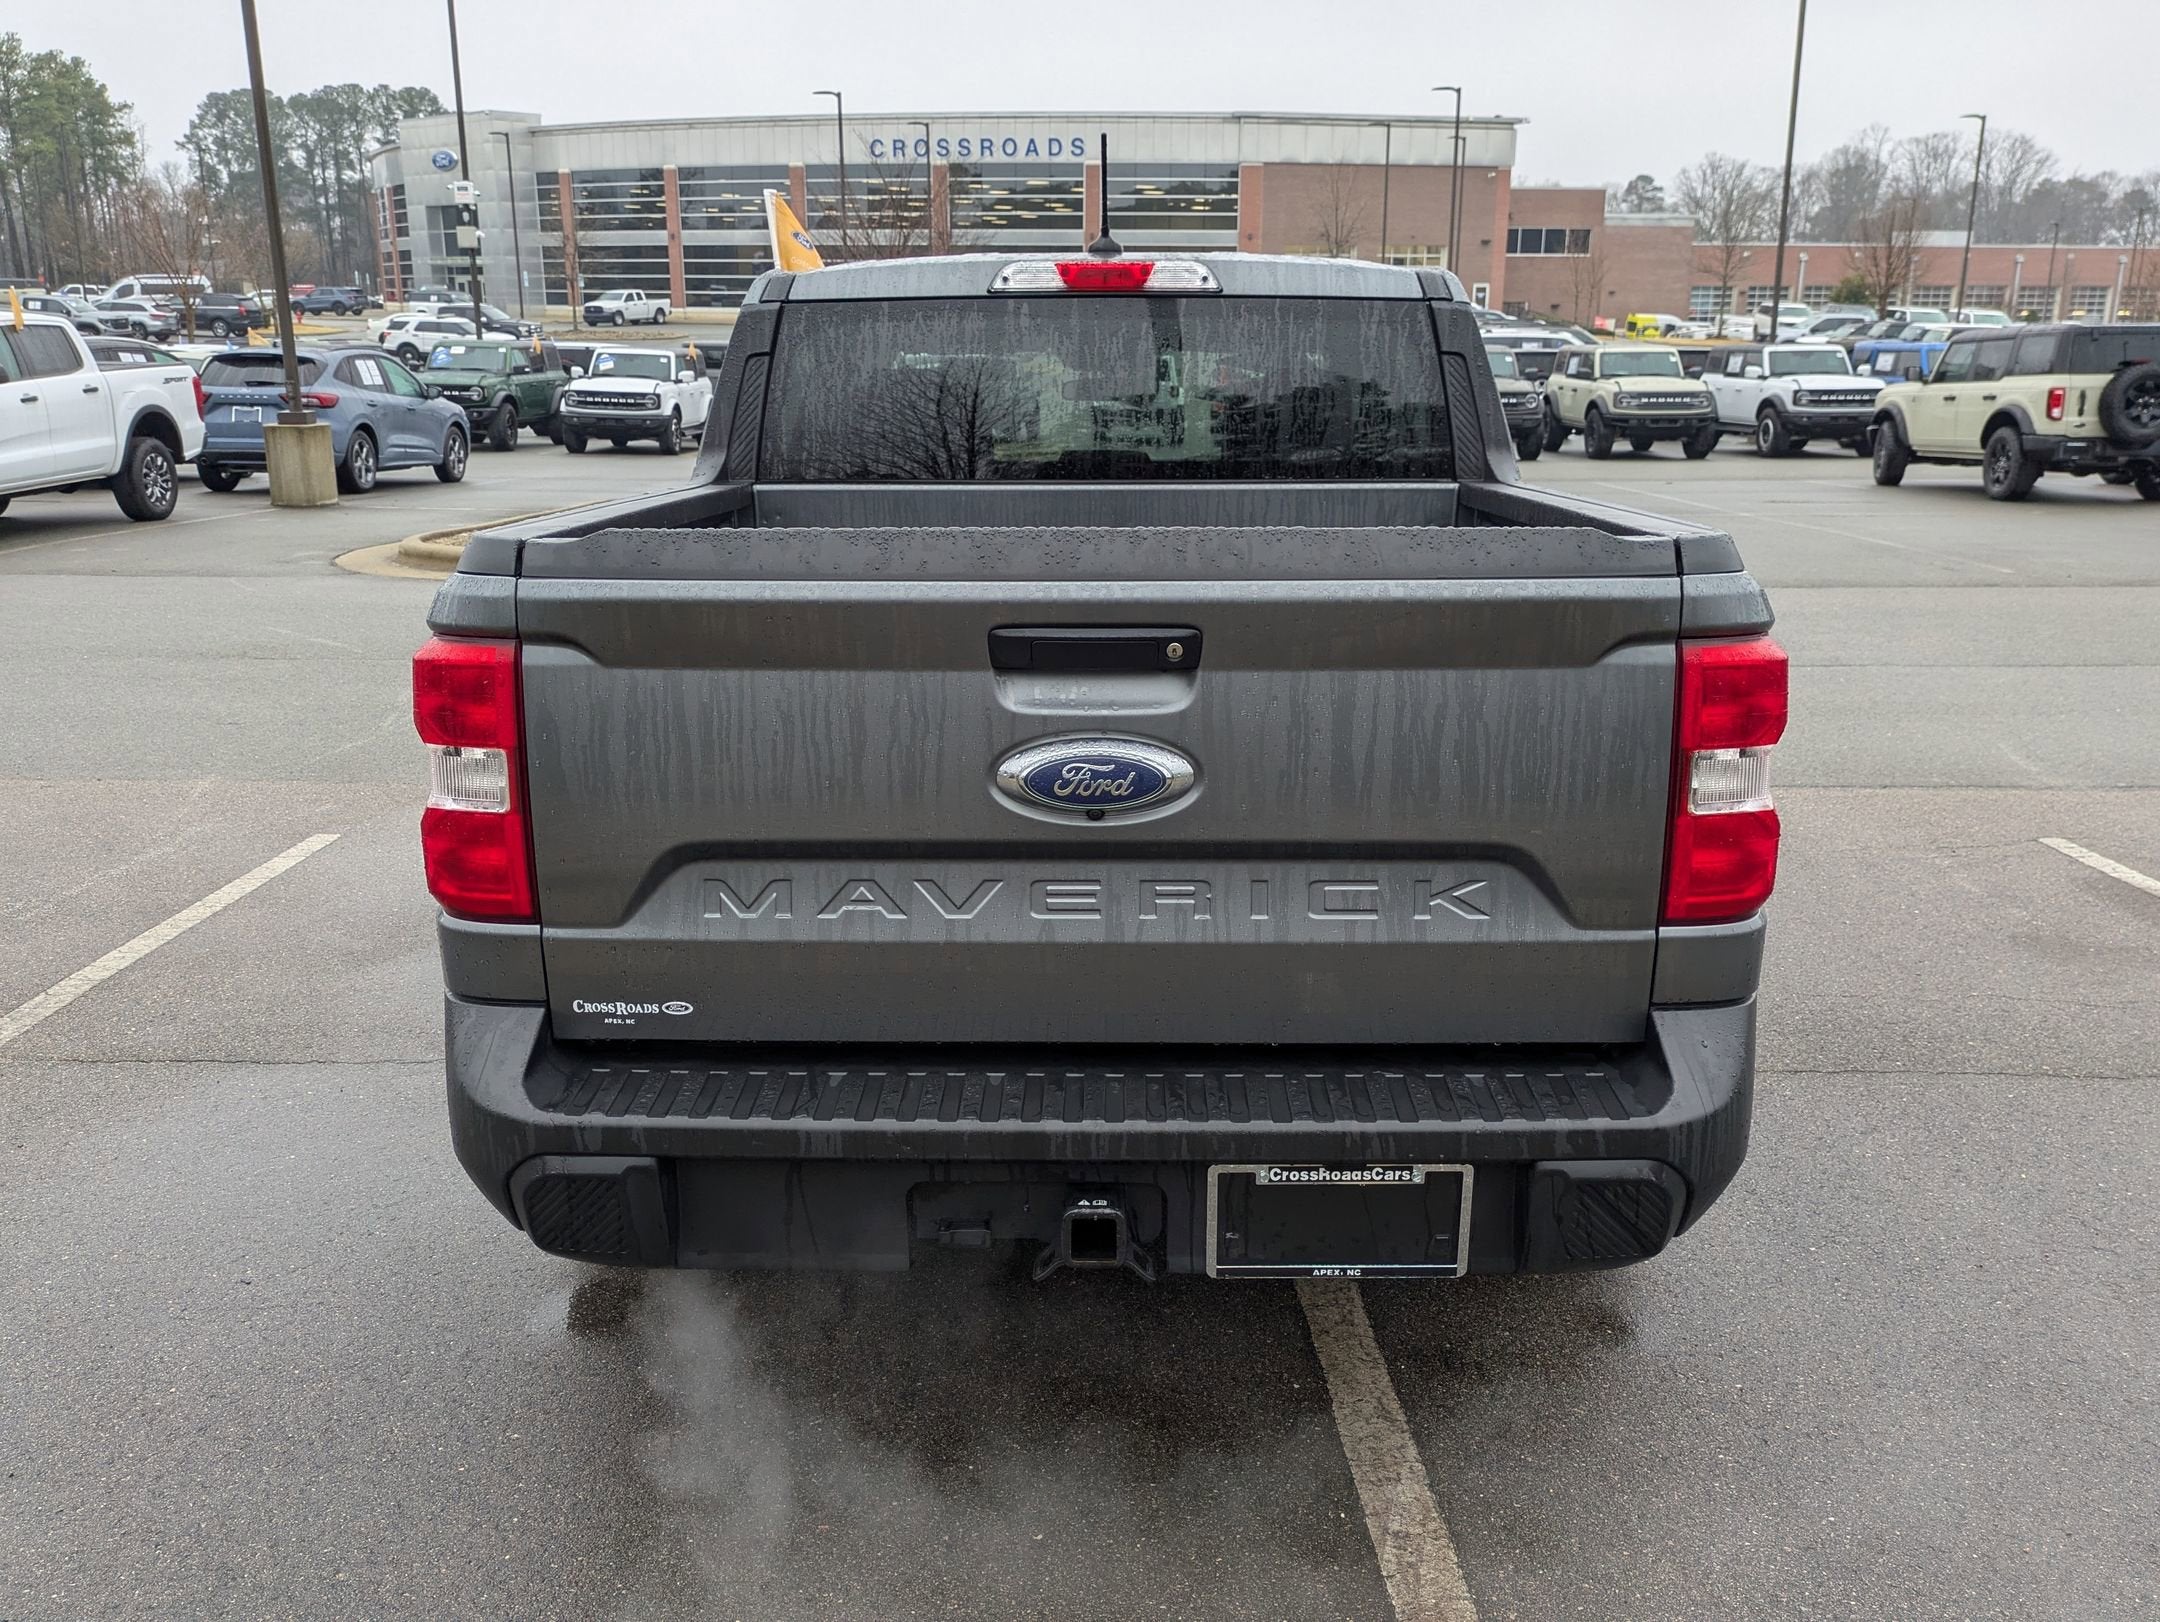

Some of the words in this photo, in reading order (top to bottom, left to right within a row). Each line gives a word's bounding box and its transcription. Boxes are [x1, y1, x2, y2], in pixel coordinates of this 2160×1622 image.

[869, 137, 1085, 158] CROSSROADS
[1053, 763, 1136, 797] Ford
[704, 879, 1491, 920] MAVERICK
[1312, 1268, 1344, 1277] APEX,
[1346, 1268, 1361, 1277] NC
